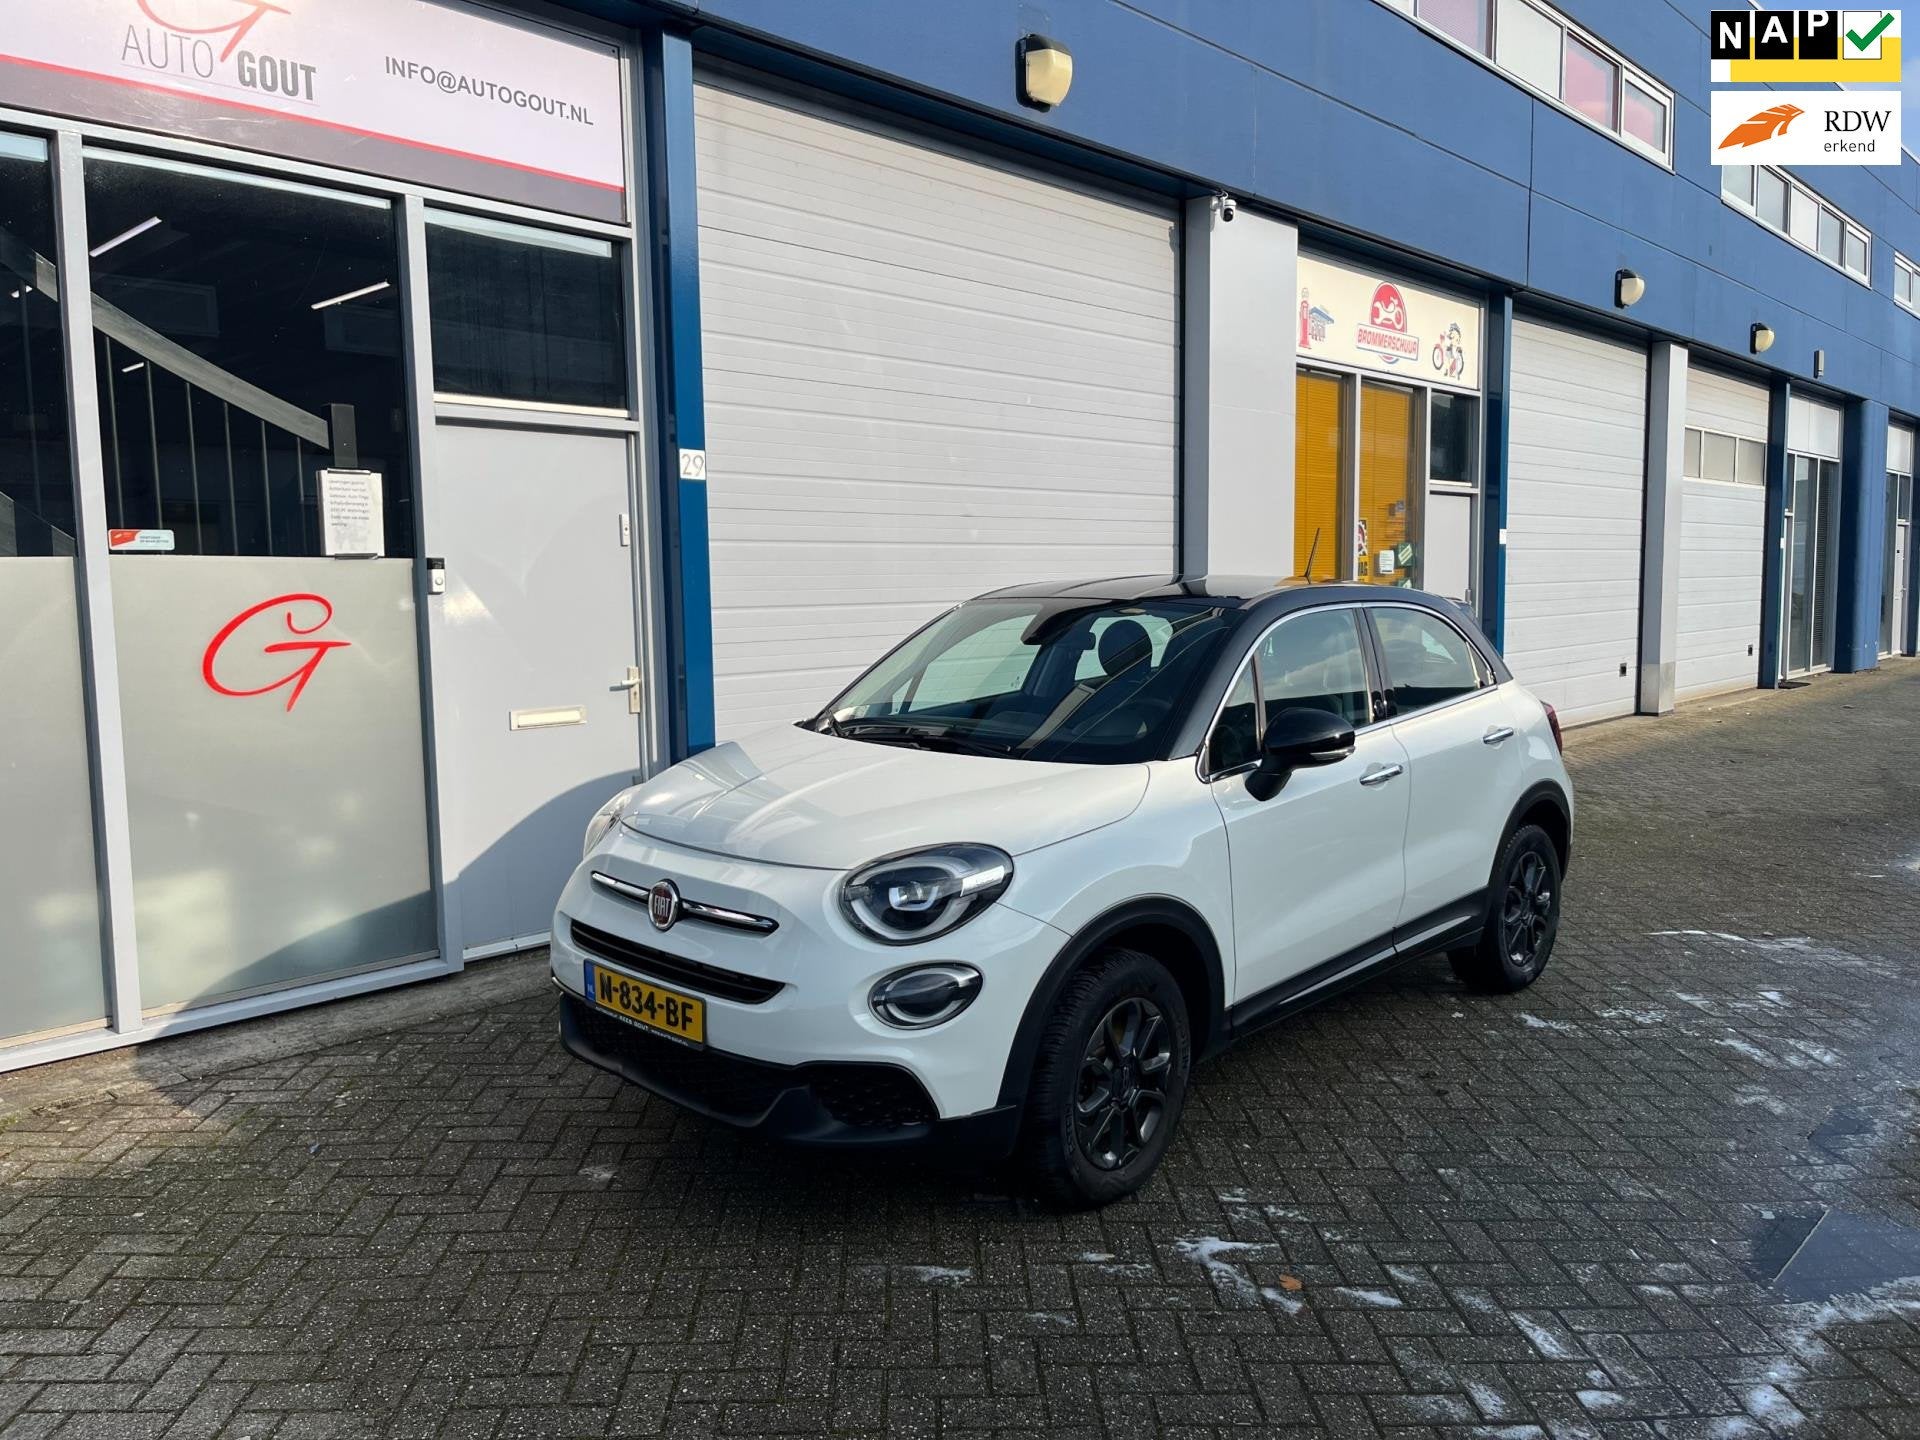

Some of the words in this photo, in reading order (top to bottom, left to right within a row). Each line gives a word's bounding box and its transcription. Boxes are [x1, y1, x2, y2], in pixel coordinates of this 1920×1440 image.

[121, 24, 214, 78] AUTO
[237, 50, 317, 101] GOUT
[385, 56, 594, 126] INFO@AUTOGOUT.NL
[1357, 328, 1417, 355] BROMMERSCHUUR
[681, 453, 704, 477] 29
[654, 894, 671, 917] FIAT
[599, 971, 694, 1032] N-834-BF
